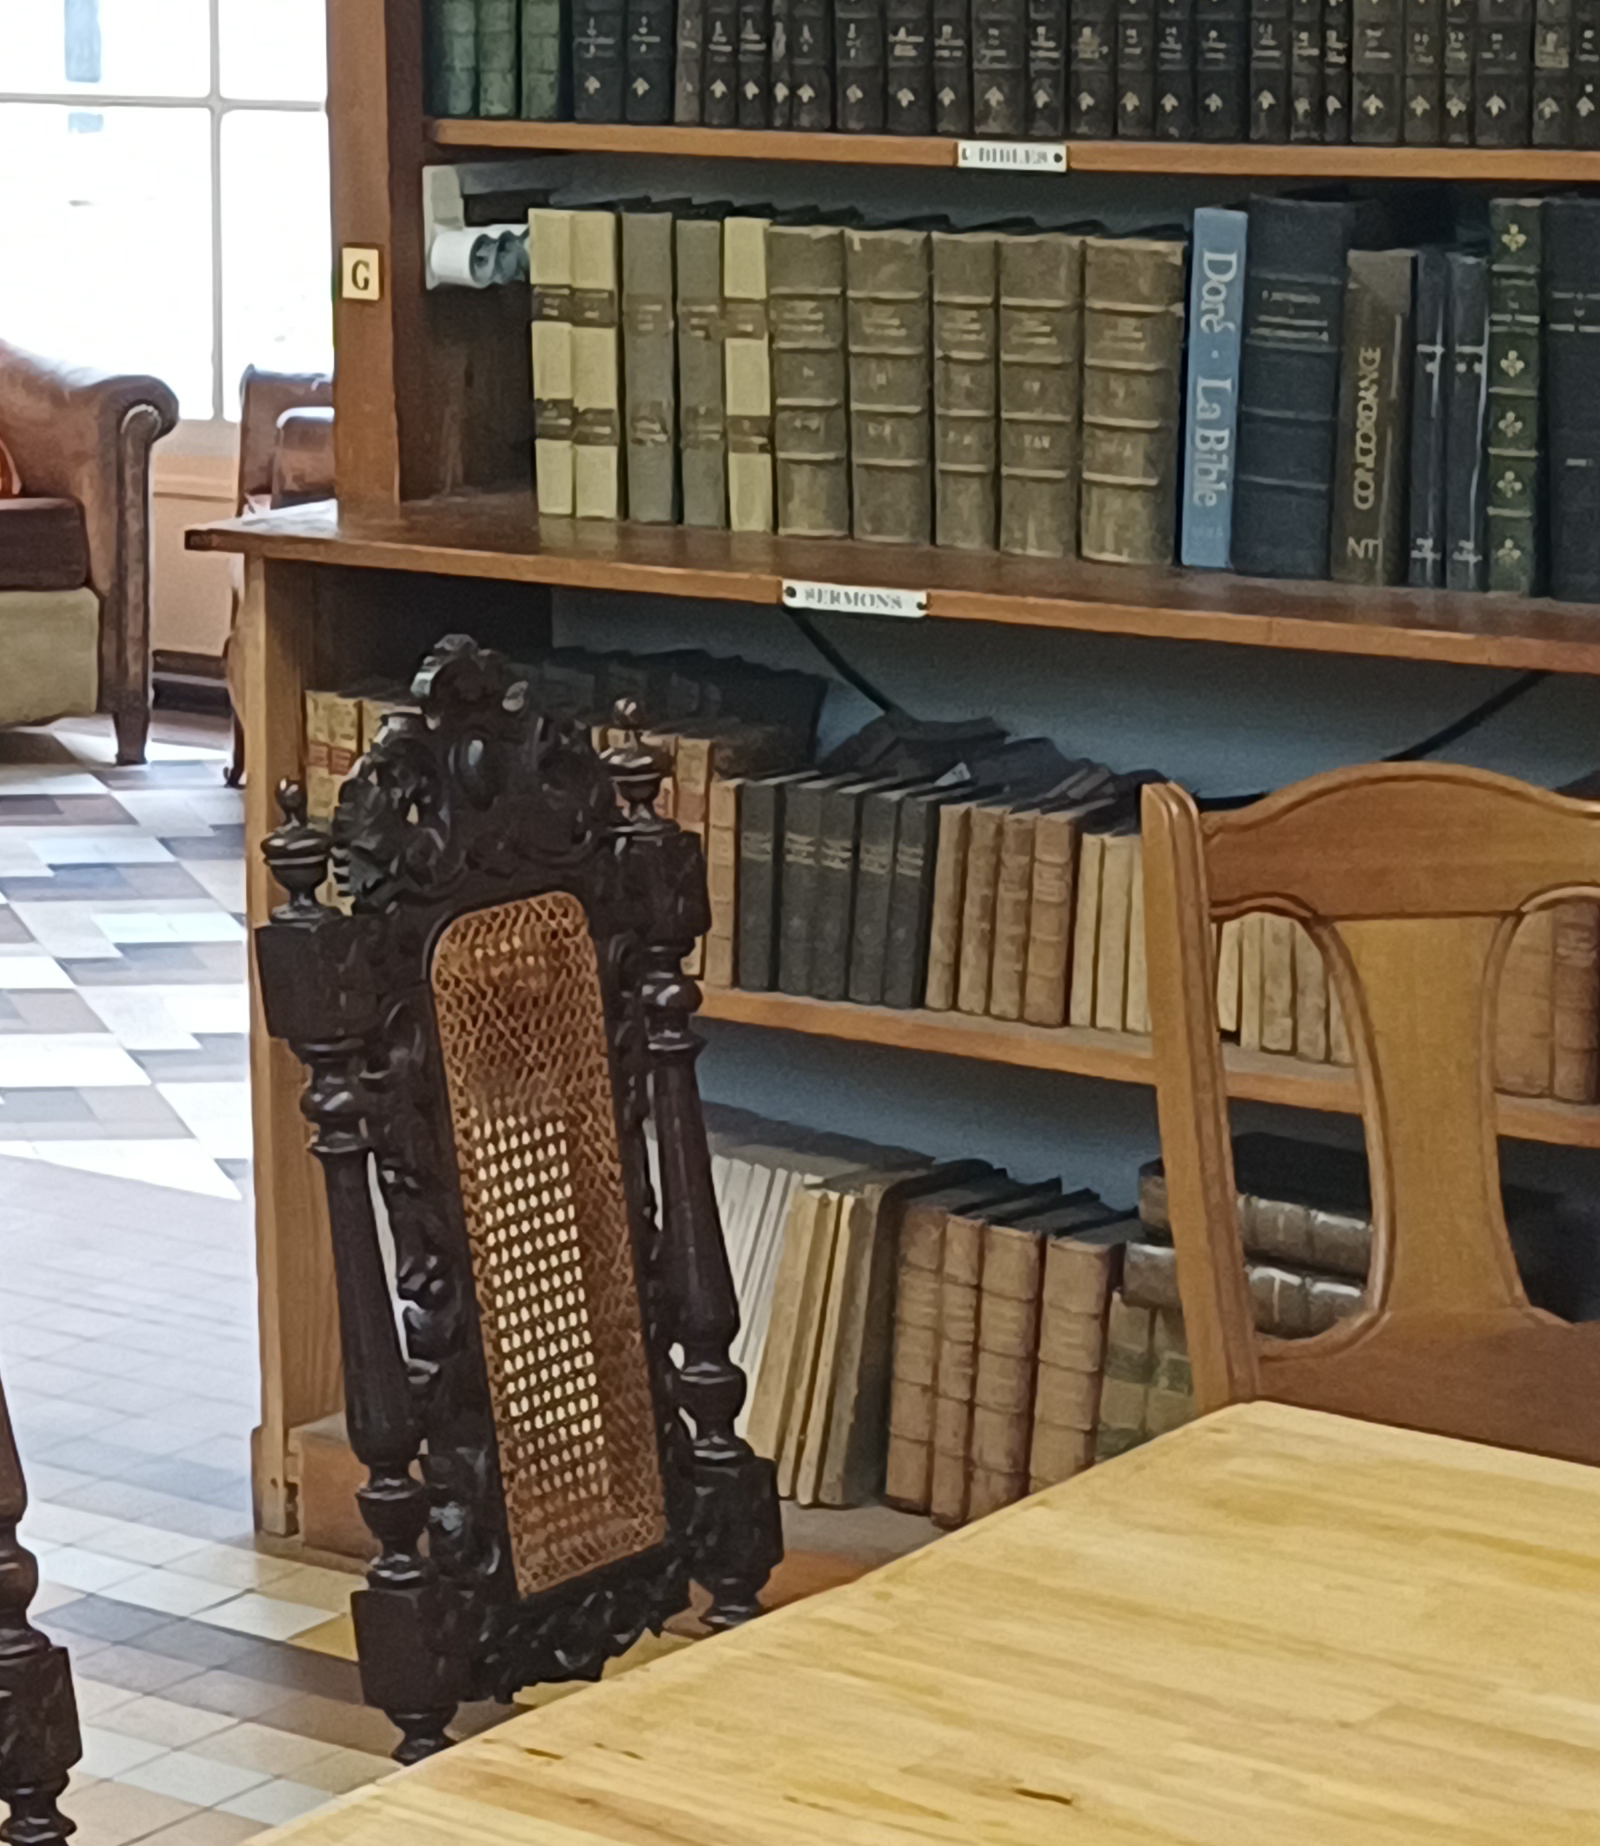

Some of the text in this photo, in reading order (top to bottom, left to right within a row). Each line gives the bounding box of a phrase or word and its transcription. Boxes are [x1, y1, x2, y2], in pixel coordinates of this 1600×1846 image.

[350, 260, 371, 292] G
[1192, 247, 1238, 509] Doré La Bible
